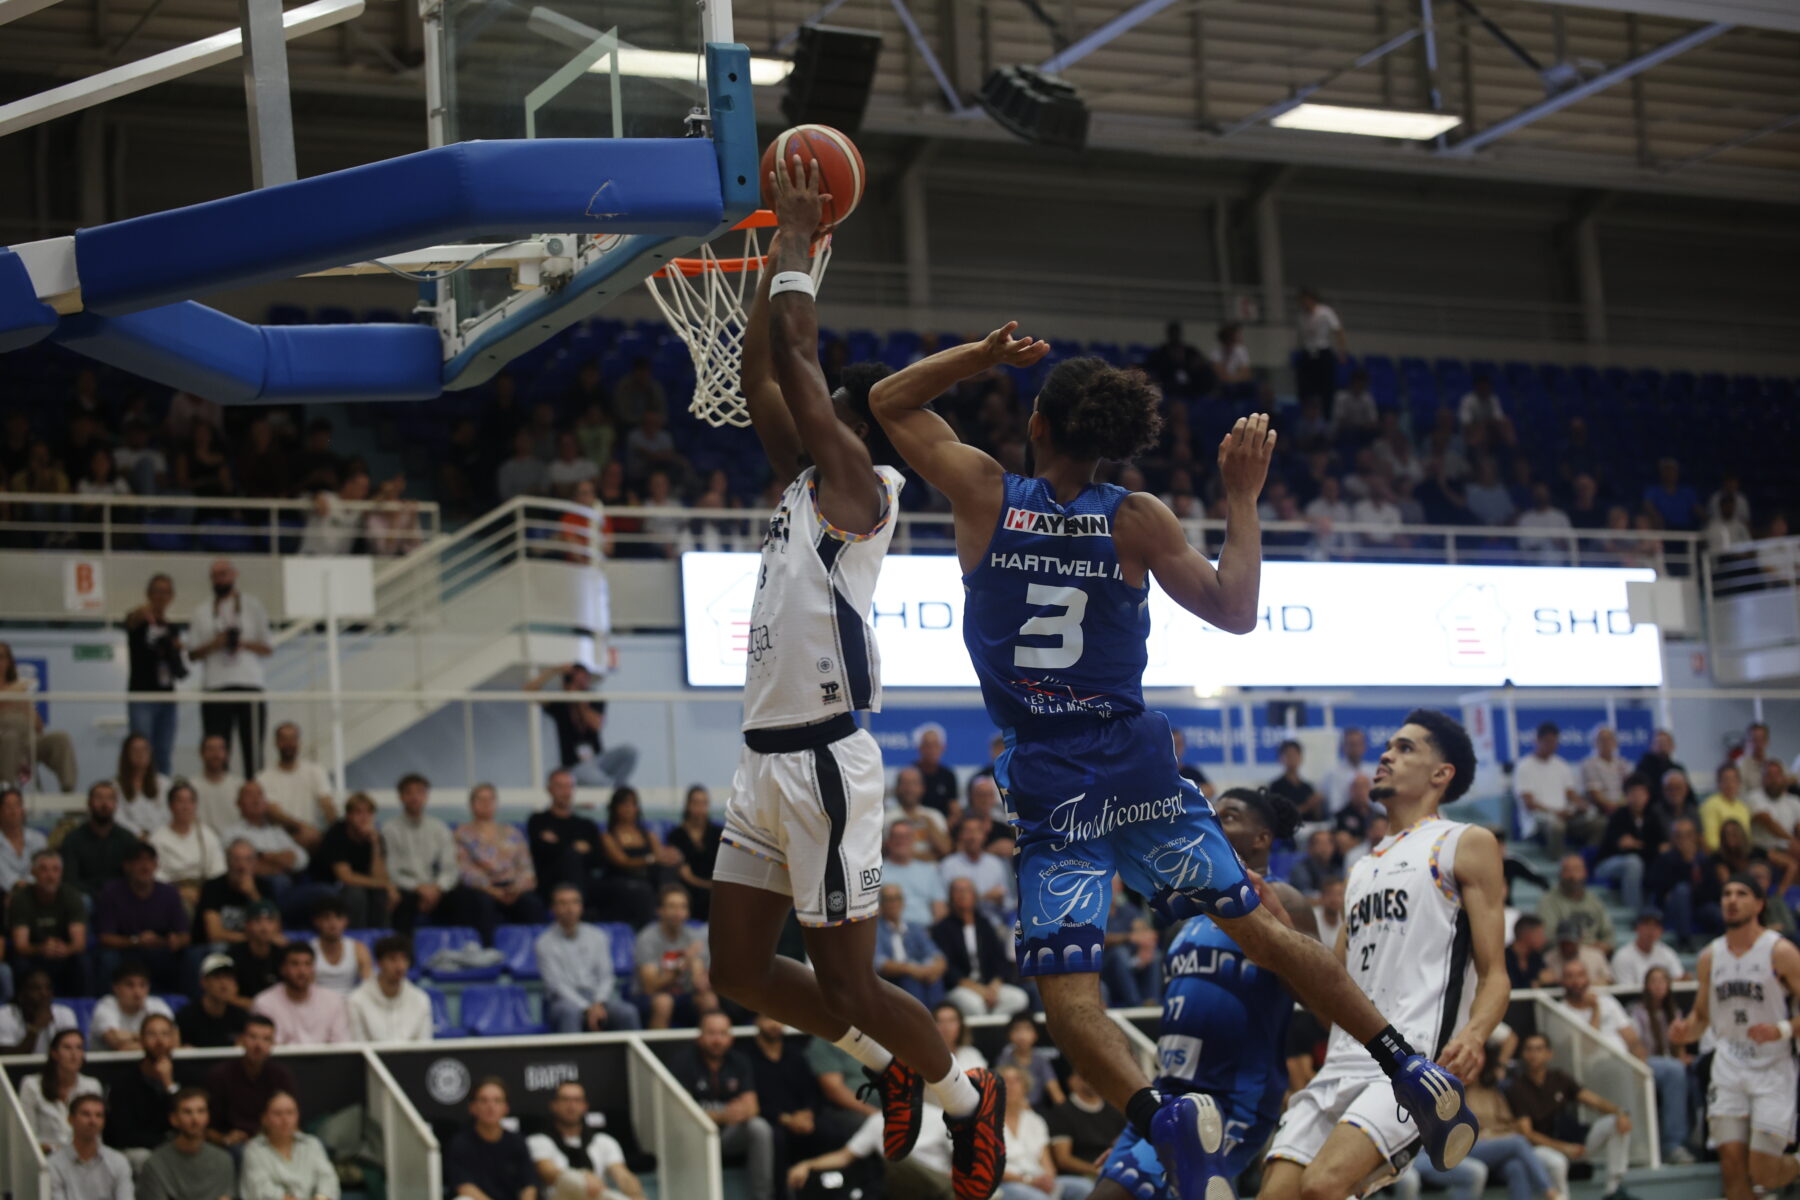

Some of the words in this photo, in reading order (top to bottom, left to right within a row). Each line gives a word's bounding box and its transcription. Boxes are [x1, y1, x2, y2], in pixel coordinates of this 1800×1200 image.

[1006, 509, 1113, 535] MAYENN
[76, 563, 94, 594] B
[991, 553, 1107, 578] HARTWELL
[872, 601, 953, 630] HD
[1014, 582, 1089, 669] 3
[1534, 608, 1635, 635] SHD
[1031, 704, 1046, 715] DE
[1049, 703, 1064, 714] LA
[862, 866, 883, 886] BD
[1350, 888, 1409, 937] ENNES
